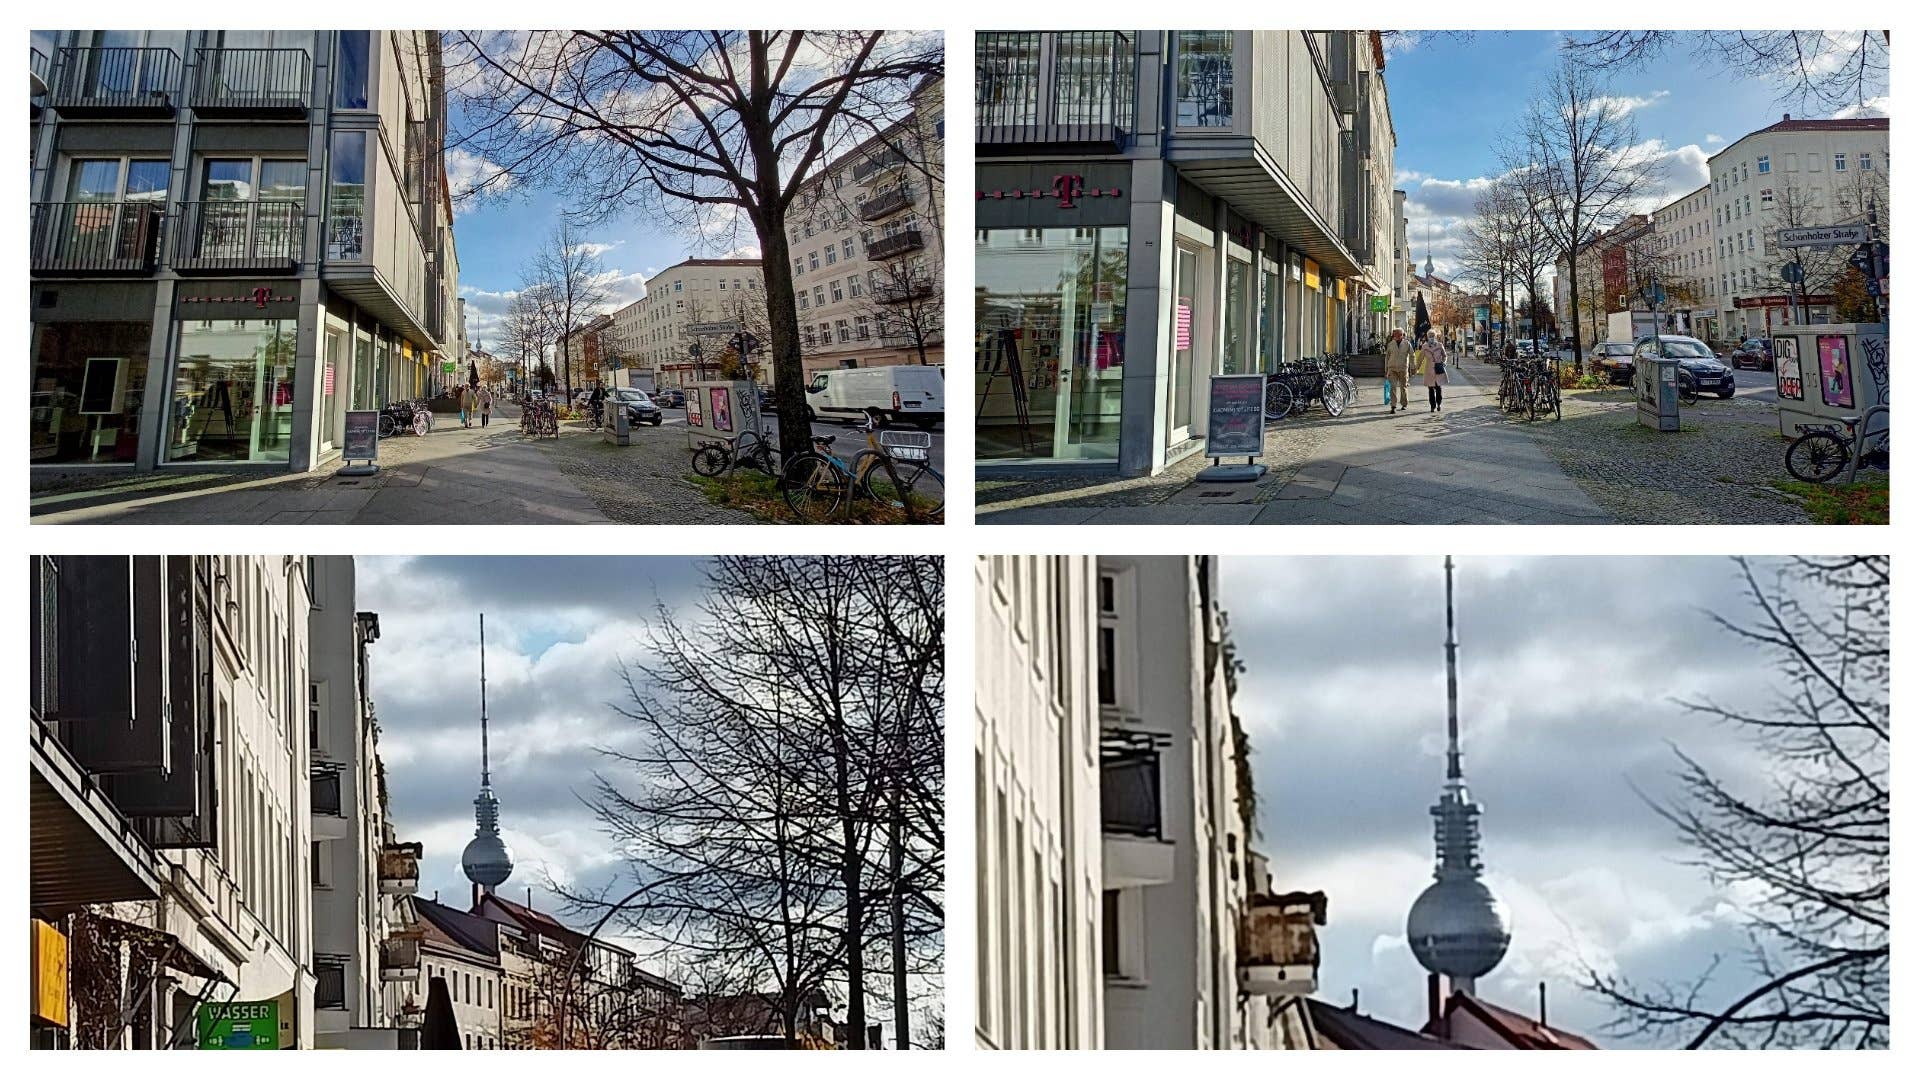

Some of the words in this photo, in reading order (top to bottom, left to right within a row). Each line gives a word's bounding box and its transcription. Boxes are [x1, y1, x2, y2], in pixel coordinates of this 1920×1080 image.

[1052, 175, 1083, 208] T
[252, 287, 272, 309] T
[1776, 340, 1791, 358] DIG
[208, 1005, 269, 1019] WASSER
